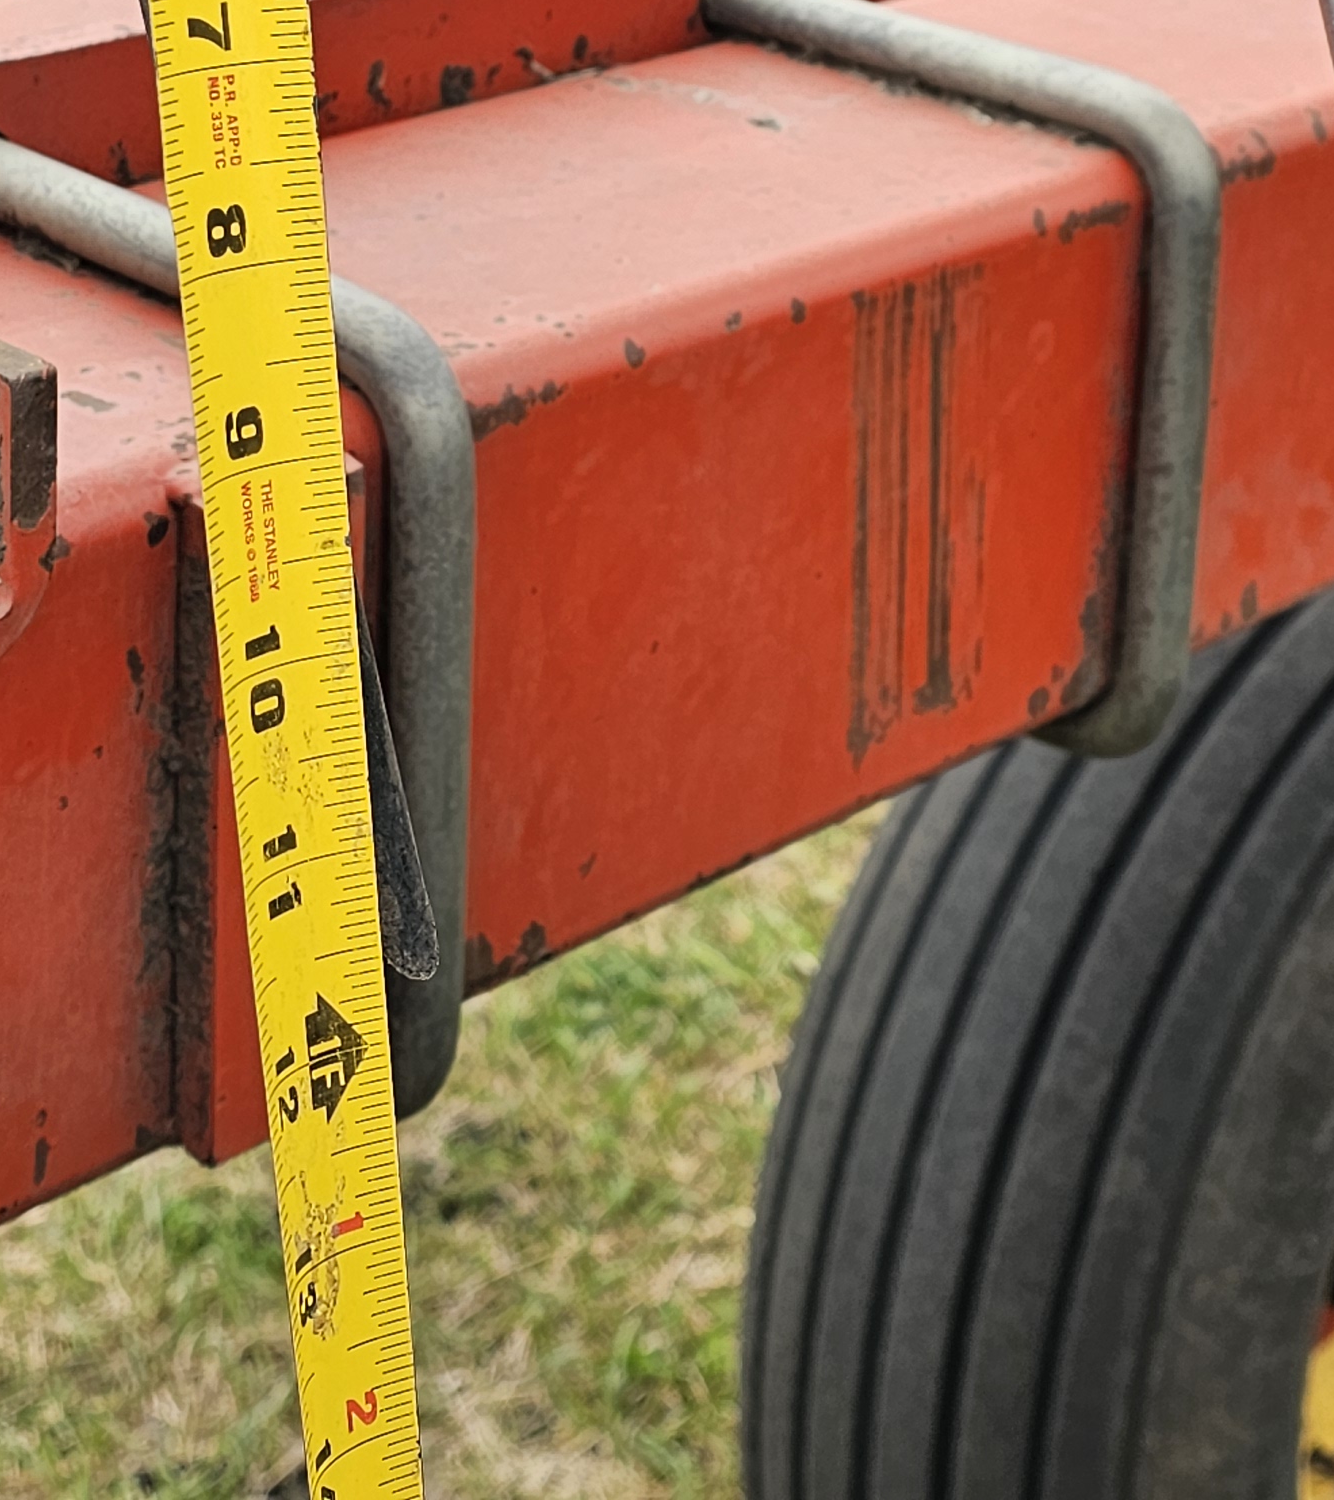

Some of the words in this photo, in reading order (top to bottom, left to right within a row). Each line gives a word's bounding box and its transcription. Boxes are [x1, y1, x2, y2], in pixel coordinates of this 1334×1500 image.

[186, 1, 232, 52] 7
[207, 76, 221, 108] NO.
[214, 146, 227, 170] TC
[206, 203, 247, 258] 8
[225, 405, 264, 461] 9
[240, 480, 256, 546] WORKS
[260, 479, 275, 514] THE
[264, 517, 280, 591] STANLEY
[245, 624, 286, 734] 10
[263, 823, 303, 921] 11
[275, 1045, 300, 1132] 12
[331, 1211, 365, 1239] 1
[346, 1390, 378, 1434] 2
